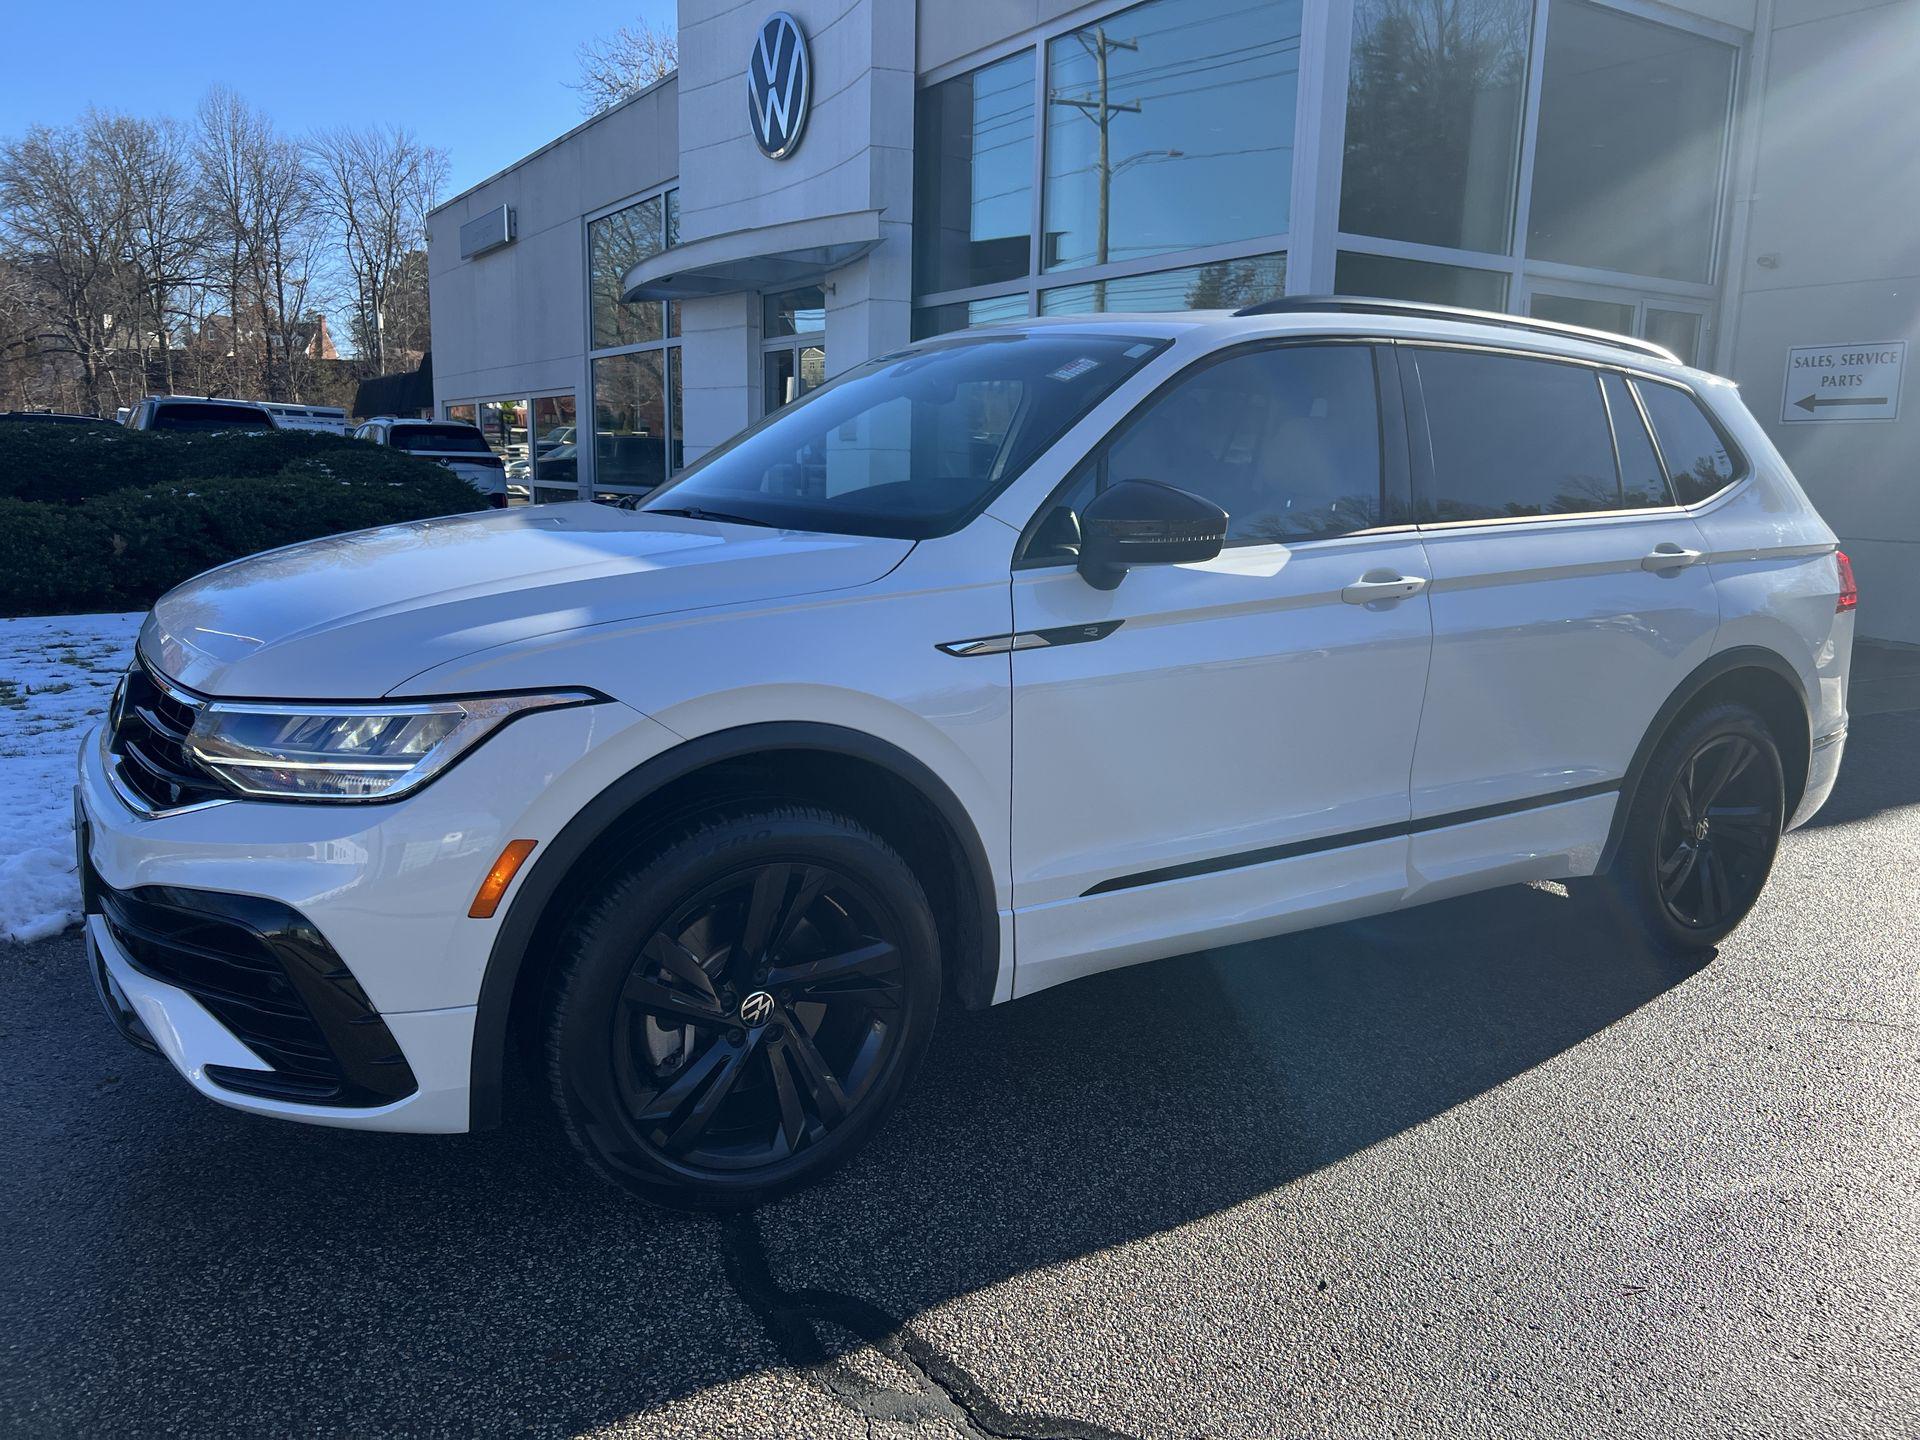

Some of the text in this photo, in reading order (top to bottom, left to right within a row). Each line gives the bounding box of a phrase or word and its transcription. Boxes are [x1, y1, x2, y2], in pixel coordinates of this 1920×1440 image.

[1794, 351, 1898, 369] SALES, SERVICE
[1820, 374, 1864, 388] PARTS
